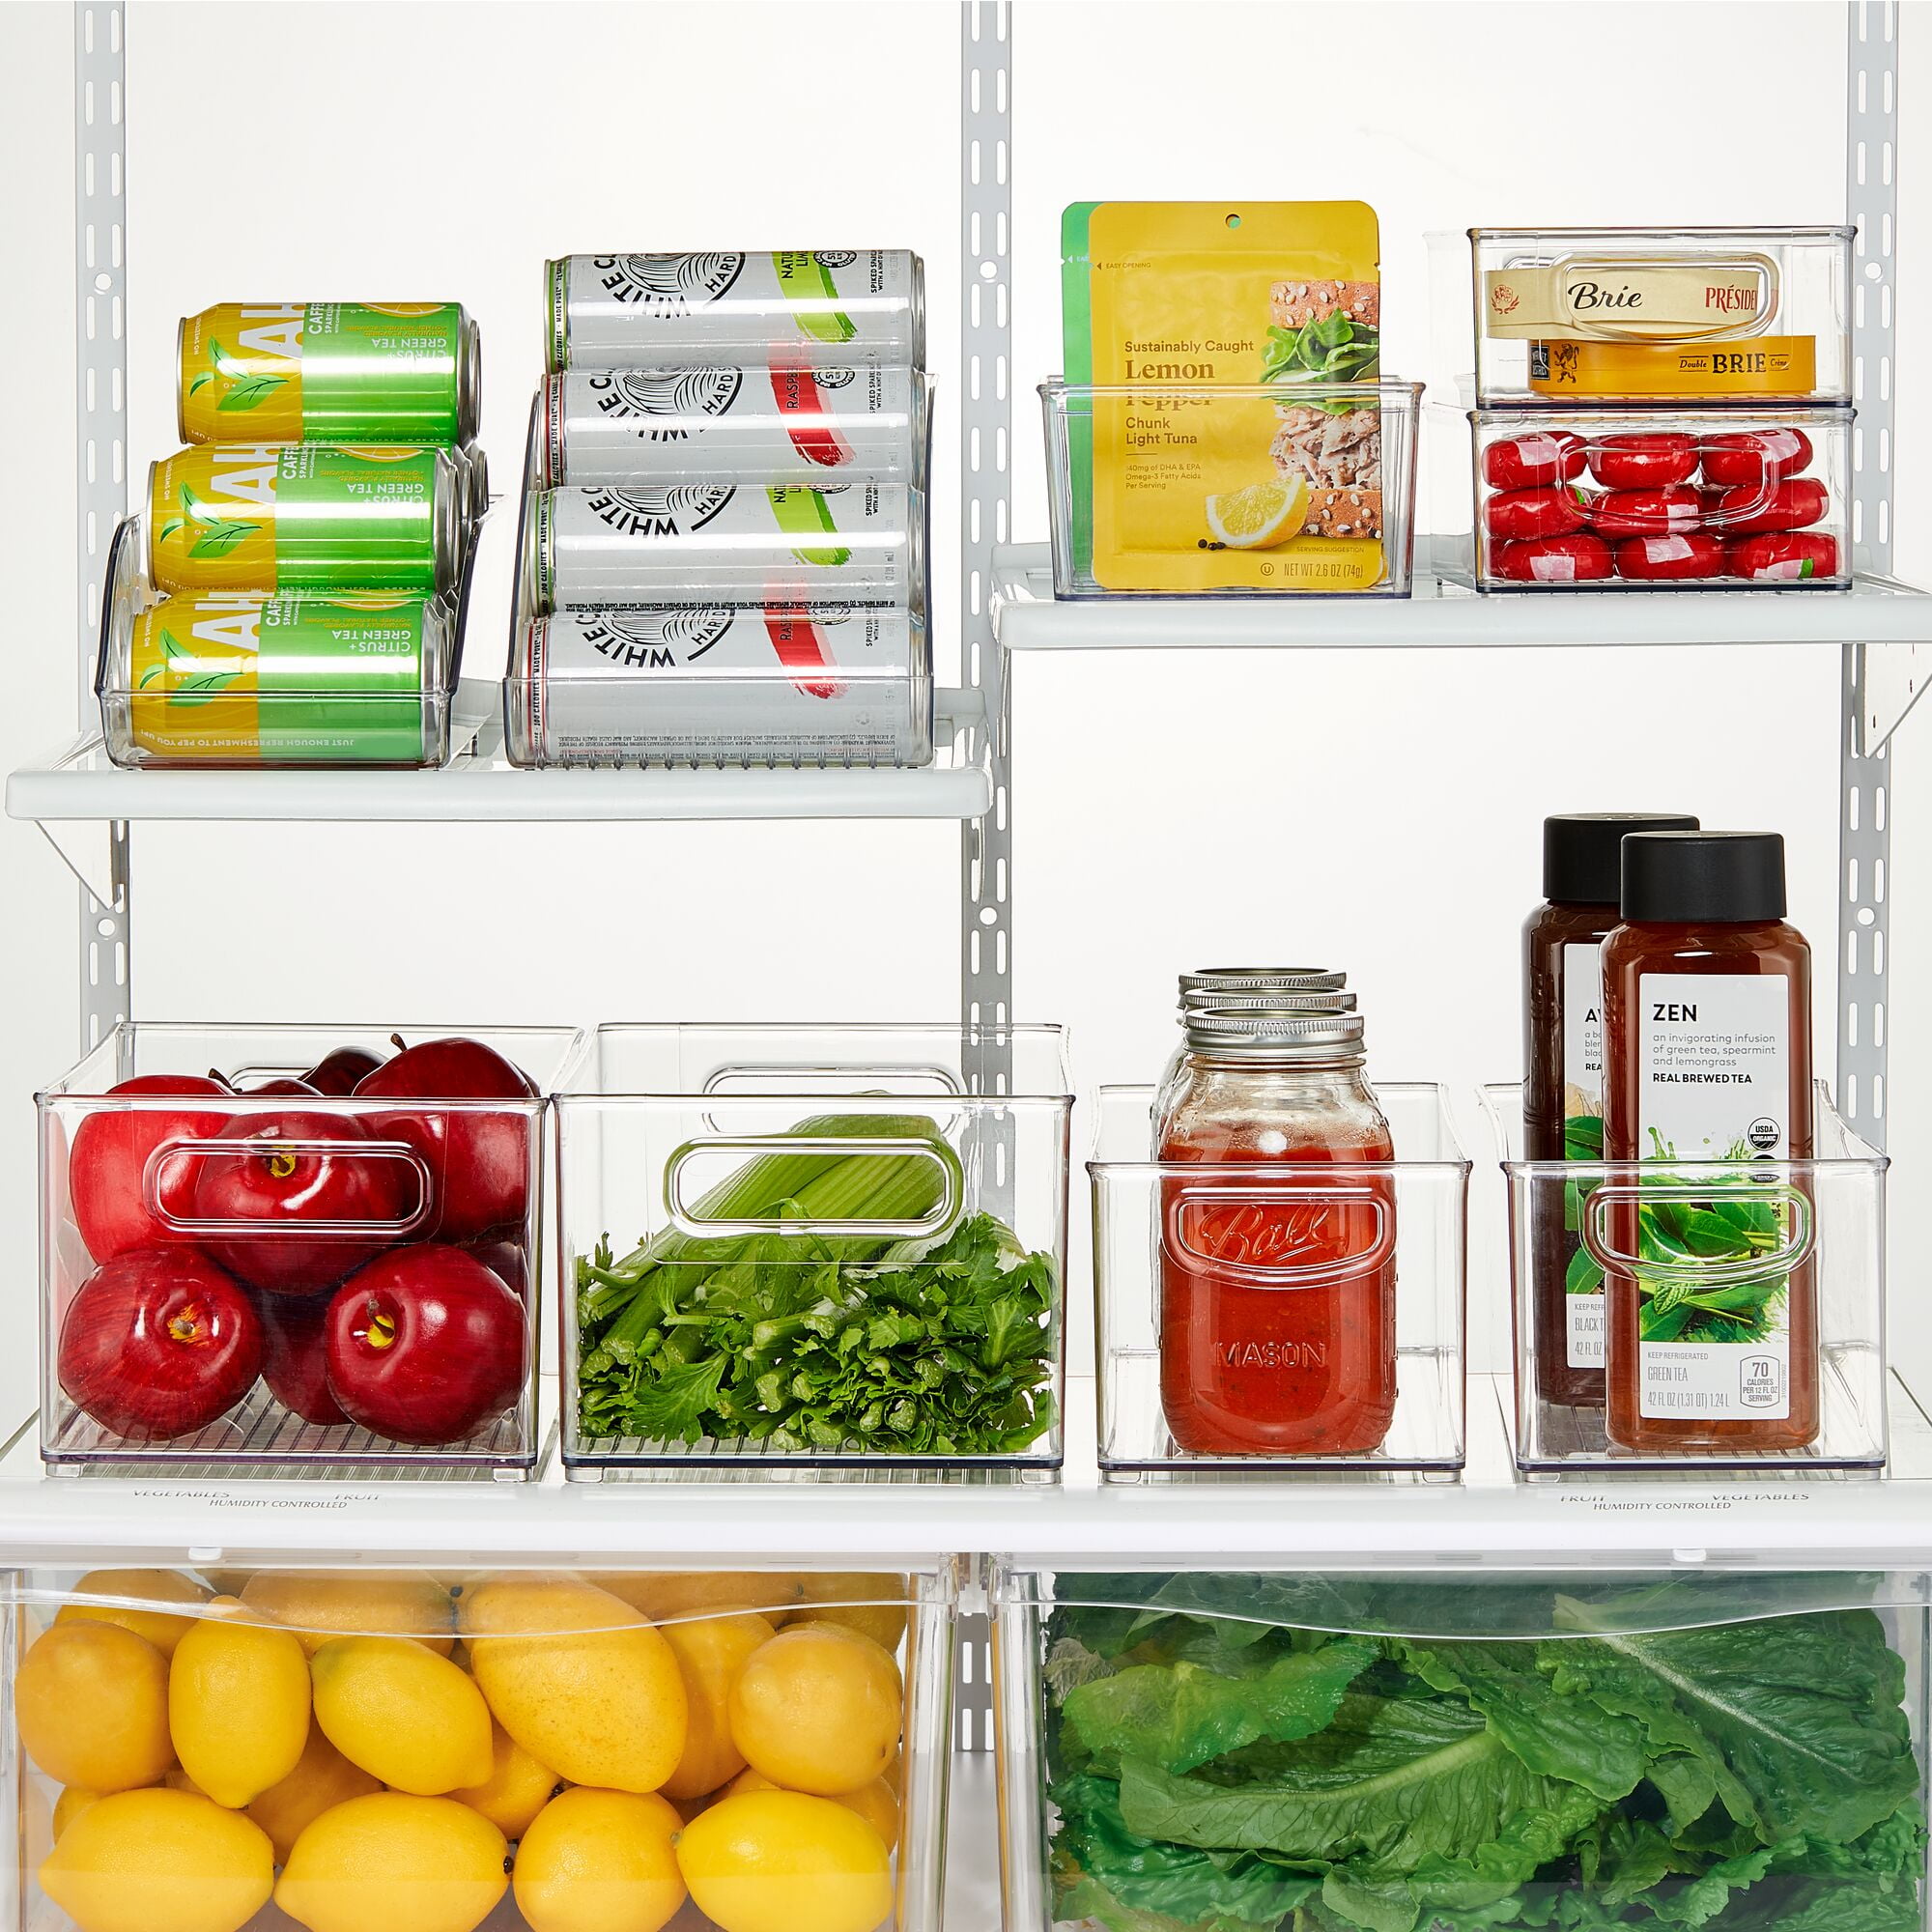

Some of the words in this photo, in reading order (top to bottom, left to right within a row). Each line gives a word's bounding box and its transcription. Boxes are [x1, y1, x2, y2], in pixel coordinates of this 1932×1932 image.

[781, 251, 794, 279] NATU
[796, 251, 809, 267] LIM
[704, 255, 737, 293] HARD
[1568, 282, 1642, 310] Brie
[372, 337, 396, 348] TEA
[401, 337, 446, 348] GREEN
[1124, 340, 1201, 355] Sustainably
[1205, 340, 1254, 355] Caught
[1125, 359, 1215, 380] Lemon
[1679, 358, 1707, 369] Double
[1712, 353, 1767, 374] BRIE
[702, 375, 734, 415] HARD
[1125, 416, 1171, 429] Chunk
[1126, 432, 1160, 447] Light
[1164, 433, 1198, 444] Tuna
[1160, 472, 1179, 481] Fatty
[347, 483, 373, 494] TEA
[377, 483, 424, 494] GREEN
[588, 496, 679, 538] WHITE
[1284, 563, 1299, 577] NET
[1300, 563, 1315, 577] WT
[1316, 563, 1328, 577] 2.6
[1330, 563, 1342, 578] OZ
[1343, 564, 1364, 579] (74g)
[331, 630, 359, 639] TEA
[362, 630, 412, 639] GREEN
[582, 627, 676, 668] WHITE
[1585, 1009, 1601, 1023] A
[1653, 1004, 1697, 1022] ZEN
[1669, 1034, 1732, 1044] invigorating
[1734, 1034, 1776, 1043] infusion
[1653, 1044, 1664, 1054] of
[1666, 1046, 1696, 1056] green
[1699, 1046, 1719, 1056] tea,
[1722, 1046, 1776, 1056] spearmint
[1653, 1057, 1673, 1065] and
[1675, 1057, 1737, 1068] lemongrass
[1653, 1073, 1681, 1083] REAL
[1682, 1073, 1730, 1083] BREWED
[1731, 1073, 1752, 1083] TEA
[1575, 1317, 1599, 1331] BLACK
[1214, 1341, 1327, 1369] MASON
[1575, 1341, 1584, 1356] 42
[1585, 1341, 1592, 1356] FL
[1593, 1341, 1603, 1356] OZ
[1663, 1351, 1709, 1360] REFRIGERATED
[1648, 1366, 1672, 1381] GREEN
[1673, 1367, 1689, 1381] TEA
[1751, 1361, 1769, 1378] 70
[1647, 1391, 1657, 1406] 42
[1658, 1392, 1665, 1406] FL
[1666, 1392, 1676, 1406] OZ
[1677, 1392, 1693, 1409] (1.31
[1695, 1393, 1708, 1409] QT)
[1710, 1393, 1724, 1407] 1.24
[1748, 1394, 1773, 1403] SERVING
[209, 1499, 270, 1508] HUMIDITY
[271, 1500, 348, 1509] CONTROLLED
[1594, 1502, 1651, 1511] HUMIDITY
